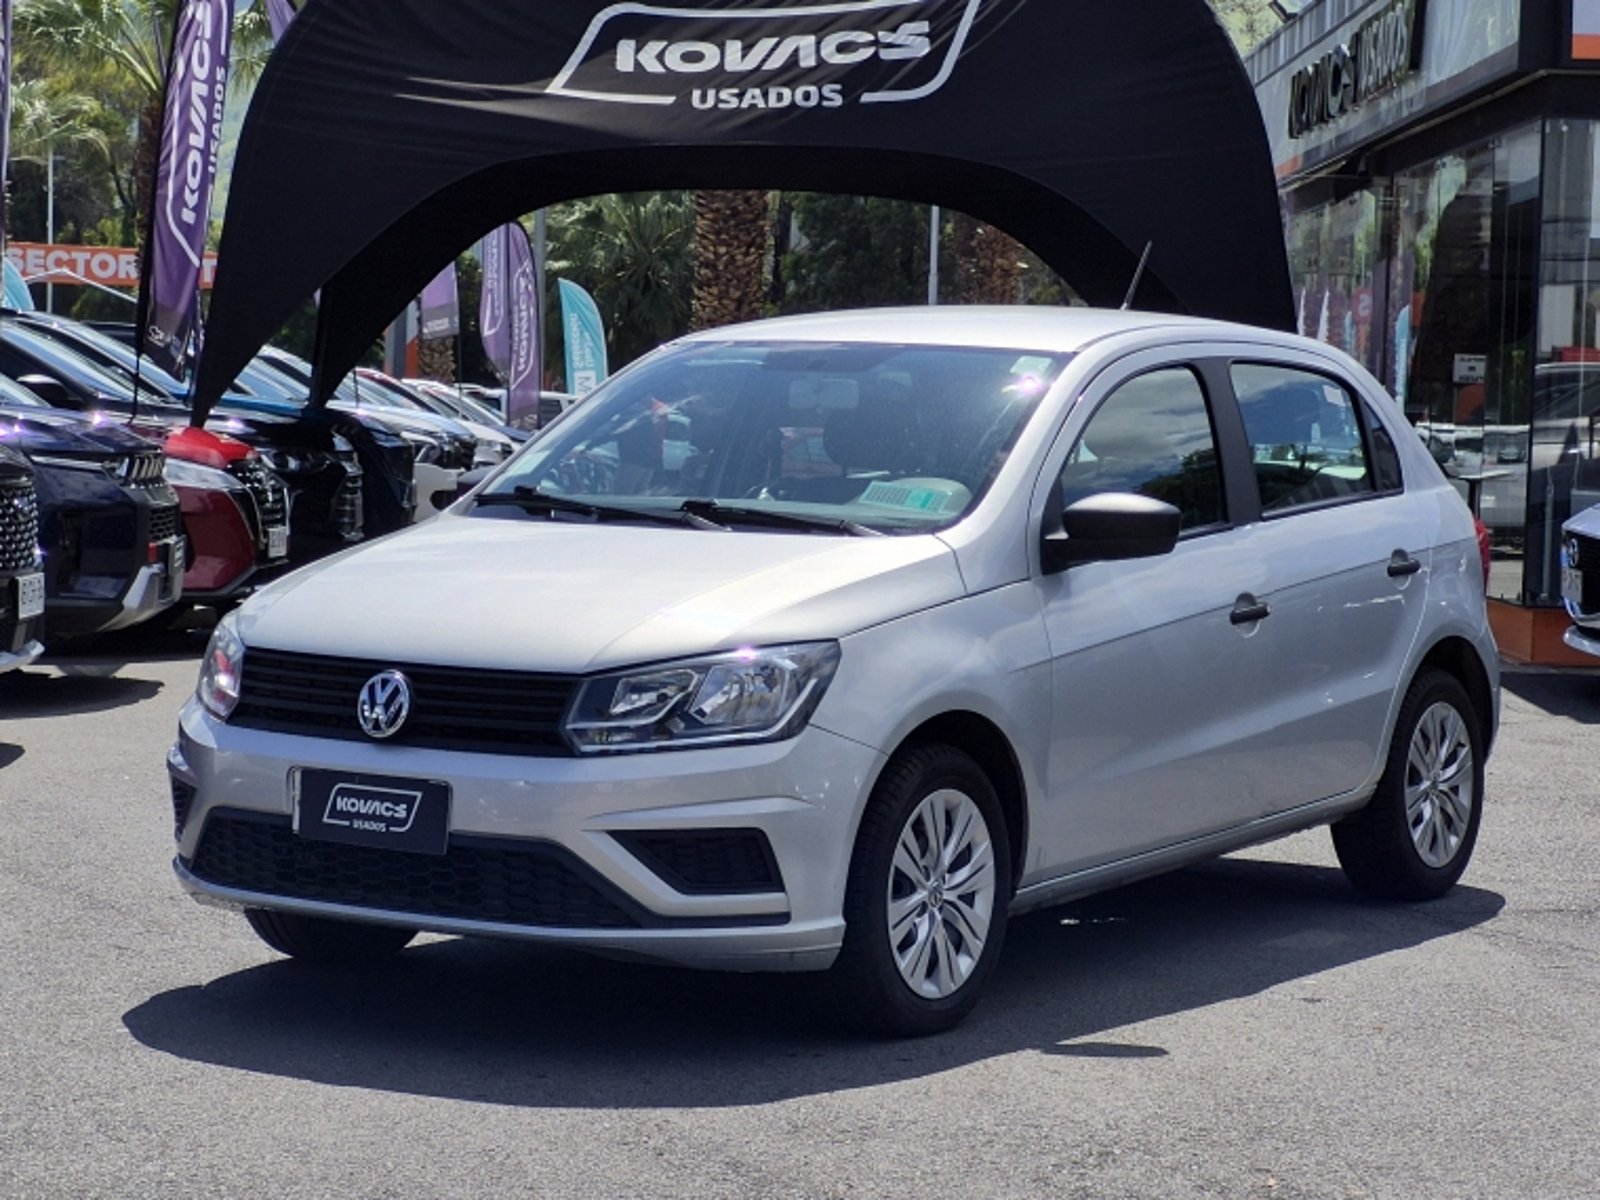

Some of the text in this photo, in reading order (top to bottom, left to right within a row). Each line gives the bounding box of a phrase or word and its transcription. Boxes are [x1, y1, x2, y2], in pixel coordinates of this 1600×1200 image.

[615, 20, 932, 74] KOVACS
[691, 83, 844, 110] USADOS
[181, 0, 211, 225] KOVACS
[6, 247, 138, 281] SECTOR
[336, 796, 407, 818] KOVACS
[352, 819, 386, 832] USADOS
